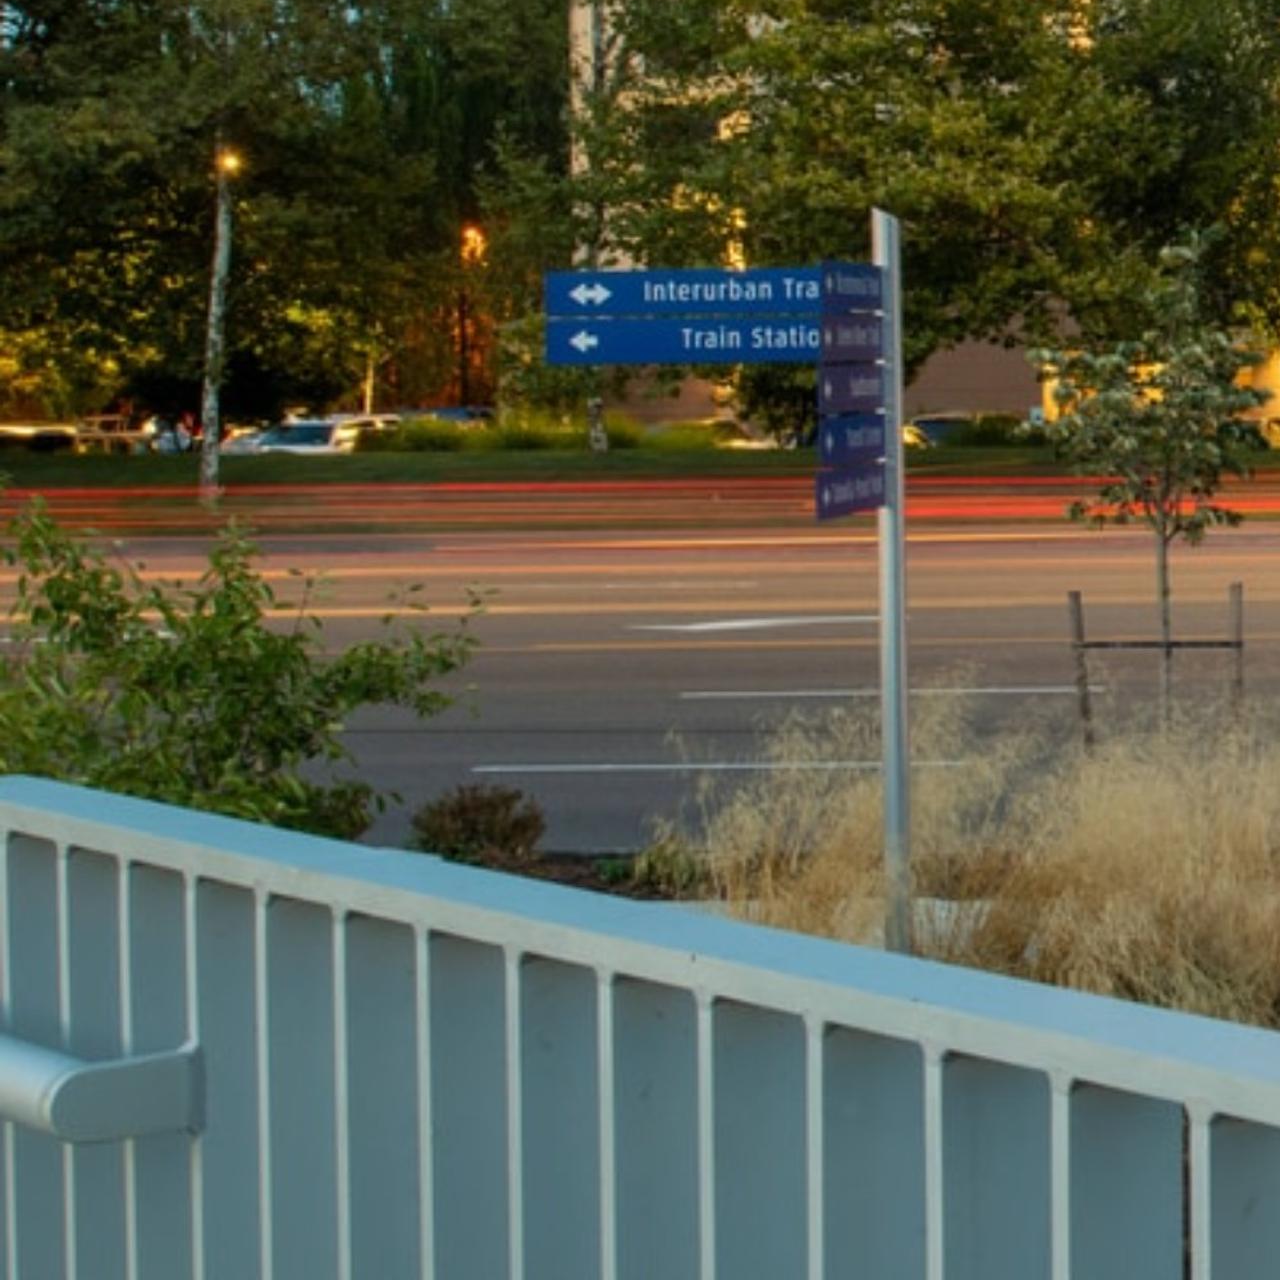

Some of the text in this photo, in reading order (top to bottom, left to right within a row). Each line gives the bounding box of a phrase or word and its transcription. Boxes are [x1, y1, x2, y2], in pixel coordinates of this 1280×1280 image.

[643, 277, 773, 301] Interurban
[782, 276, 820, 300] Tra
[681, 325, 742, 349] Train
[751, 324, 821, 349] Statio
